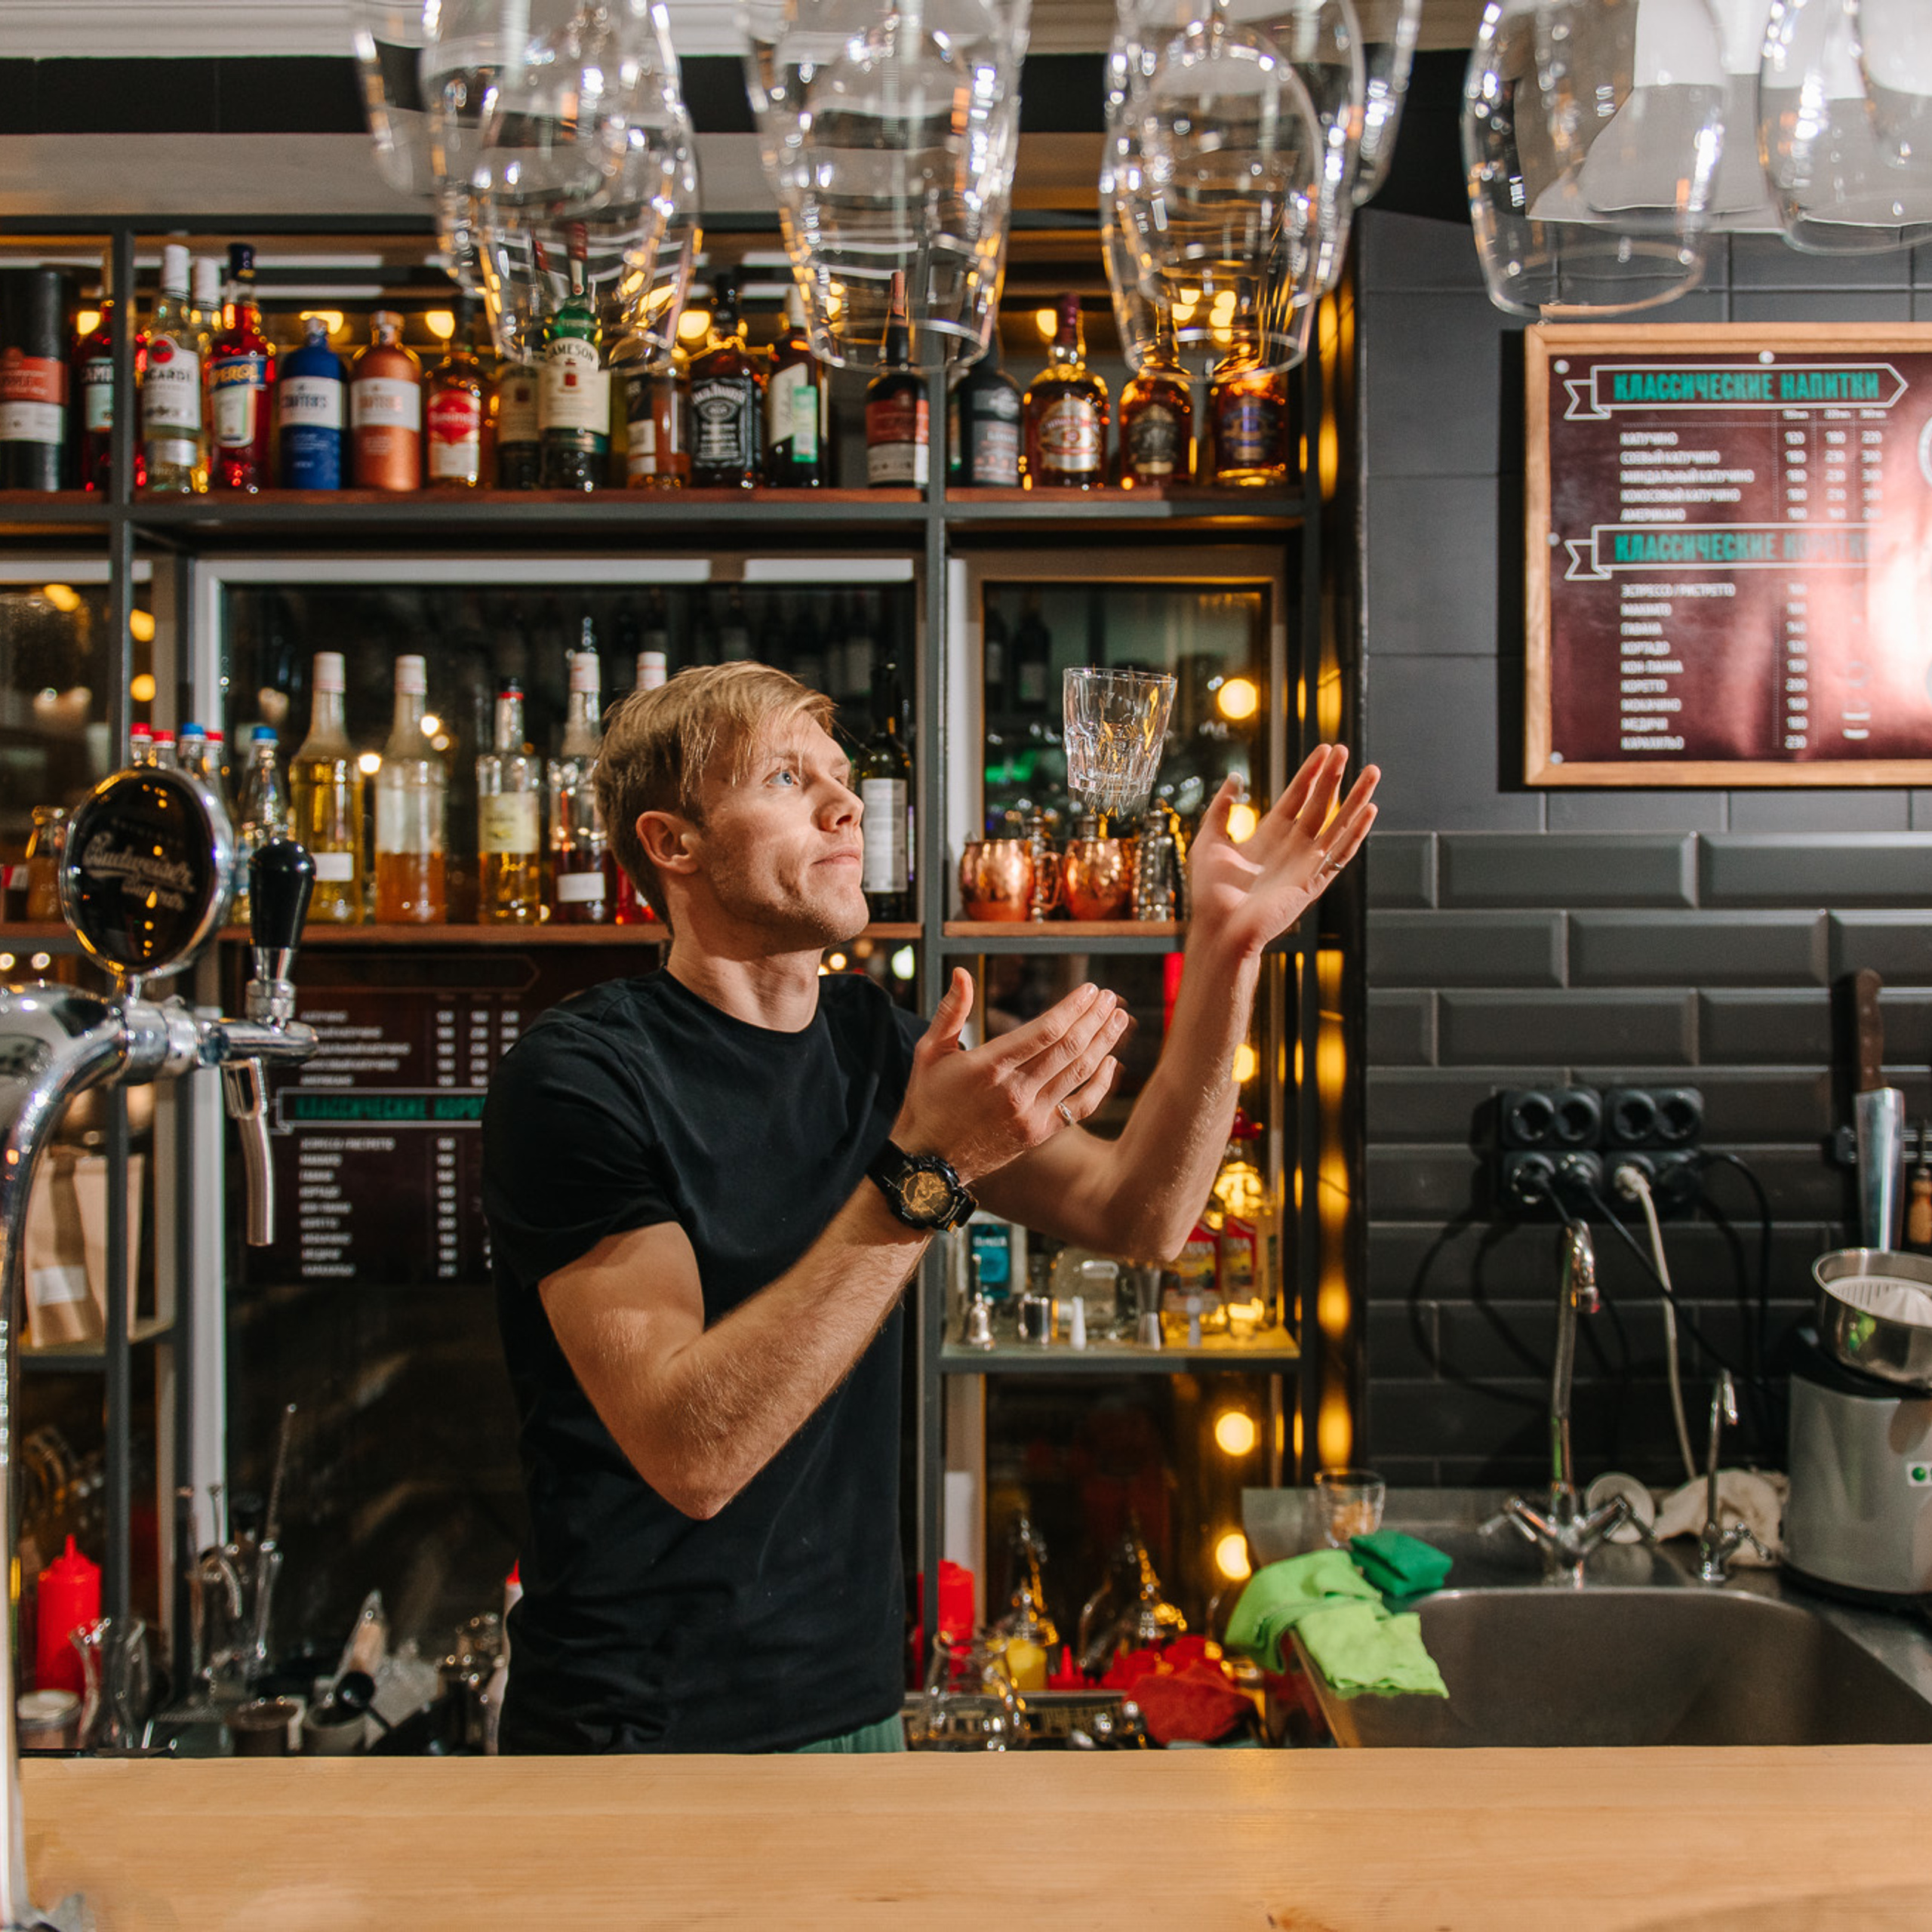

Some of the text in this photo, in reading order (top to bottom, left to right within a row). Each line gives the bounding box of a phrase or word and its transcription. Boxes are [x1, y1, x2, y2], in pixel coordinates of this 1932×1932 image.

[548, 344, 593, 361] JAMESON
[1614, 372, 1879, 401] КЛАССИЧЕСКИЕ НАПИТКИ
[1620, 432, 1678, 445] КАПУЧИНО
[1620, 449, 1721, 464] СОЕВЫЙ КАПУЧИНО
[1698, 469, 1755, 483] КАПУЧИНО
[1620, 488, 1741, 503] КОКОСОВЫЙ КАПУЧИНО
[1620, 509, 1686, 521] АМЕРИКАНО
[1615, 532, 1869, 561] КЛАССИЧЕСКИЕ КОРОТК
[1621, 583, 1672, 598] ЭСПРЕССО
[1679, 583, 1736, 597] РИСТРЕТТО
[1620, 641, 1671, 656] КОРТАДО
[1620, 679, 1667, 693] КОРЕТТО
[1620, 698, 1682, 712] МОКАЧИНО
[1620, 718, 1669, 731] МЕДИЧИ
